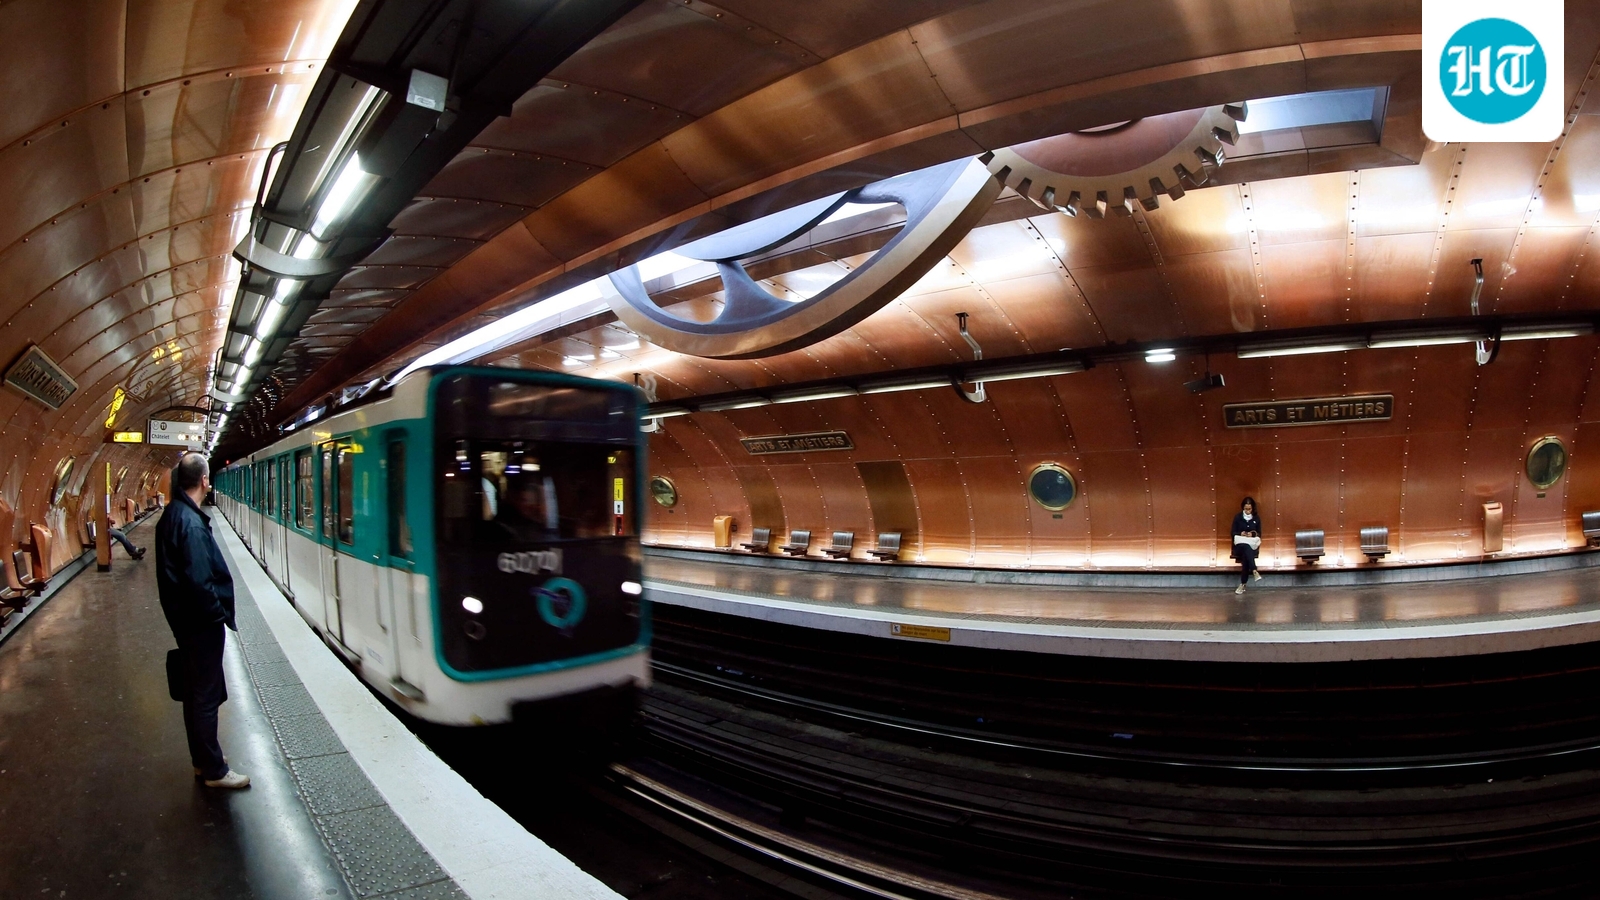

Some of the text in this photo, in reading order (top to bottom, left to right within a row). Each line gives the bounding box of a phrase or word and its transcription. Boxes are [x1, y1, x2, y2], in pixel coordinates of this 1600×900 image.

[14, 358, 41, 383] ARTS
[33, 371, 51, 388] ET
[1234, 402, 1385, 422] ARTS ET MÉTIERS
[748, 436, 845, 451] ARTS ET MÉTIERS
